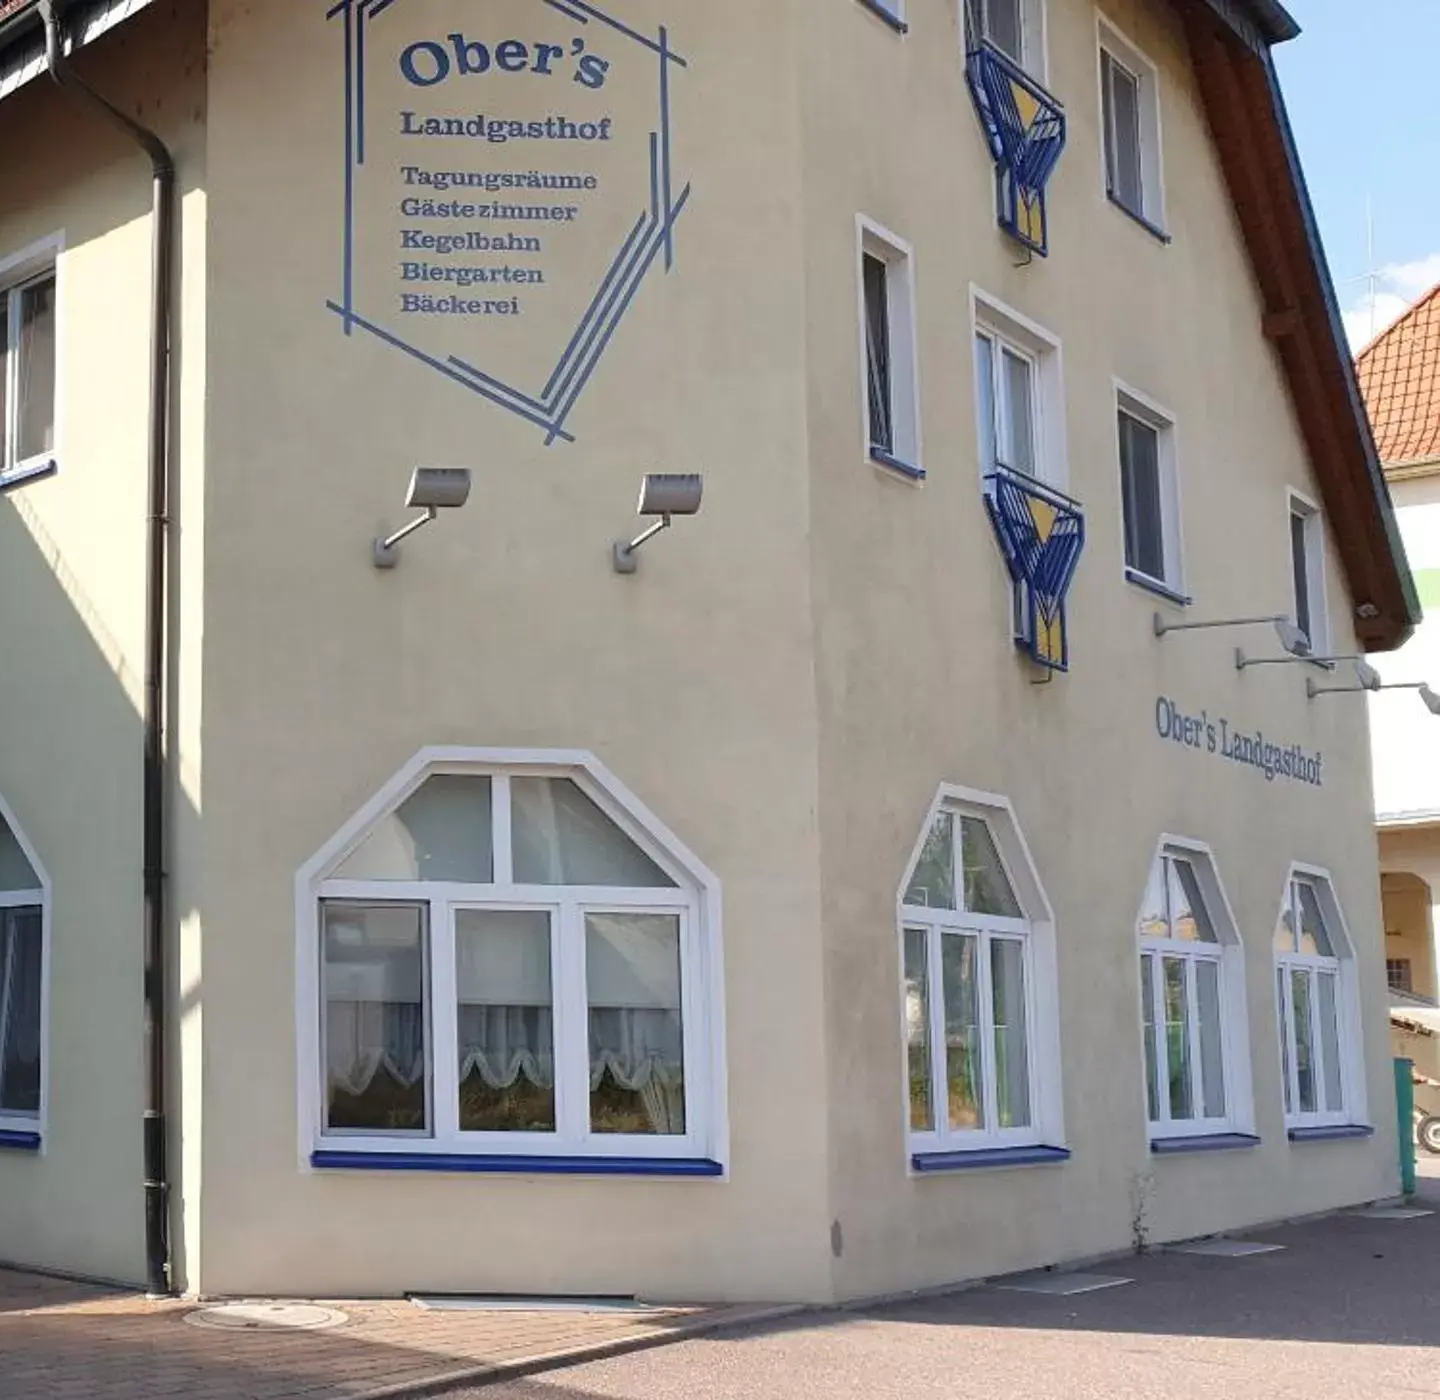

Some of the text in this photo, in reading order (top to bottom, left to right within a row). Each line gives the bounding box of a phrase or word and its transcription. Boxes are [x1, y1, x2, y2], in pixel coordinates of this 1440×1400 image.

[399, 33, 610, 89] Ober's
[400, 111, 611, 143] Landgasthof
[401, 166, 597, 191] Tagungsräume
[400, 198, 578, 221] Gästezimmer
[400, 230, 540, 254] Kegelbahn
[401, 262, 544, 286] Biergarten
[400, 294, 519, 315] Bäckerei
[1155, 696, 1322, 786] Ober's Landgasthof
